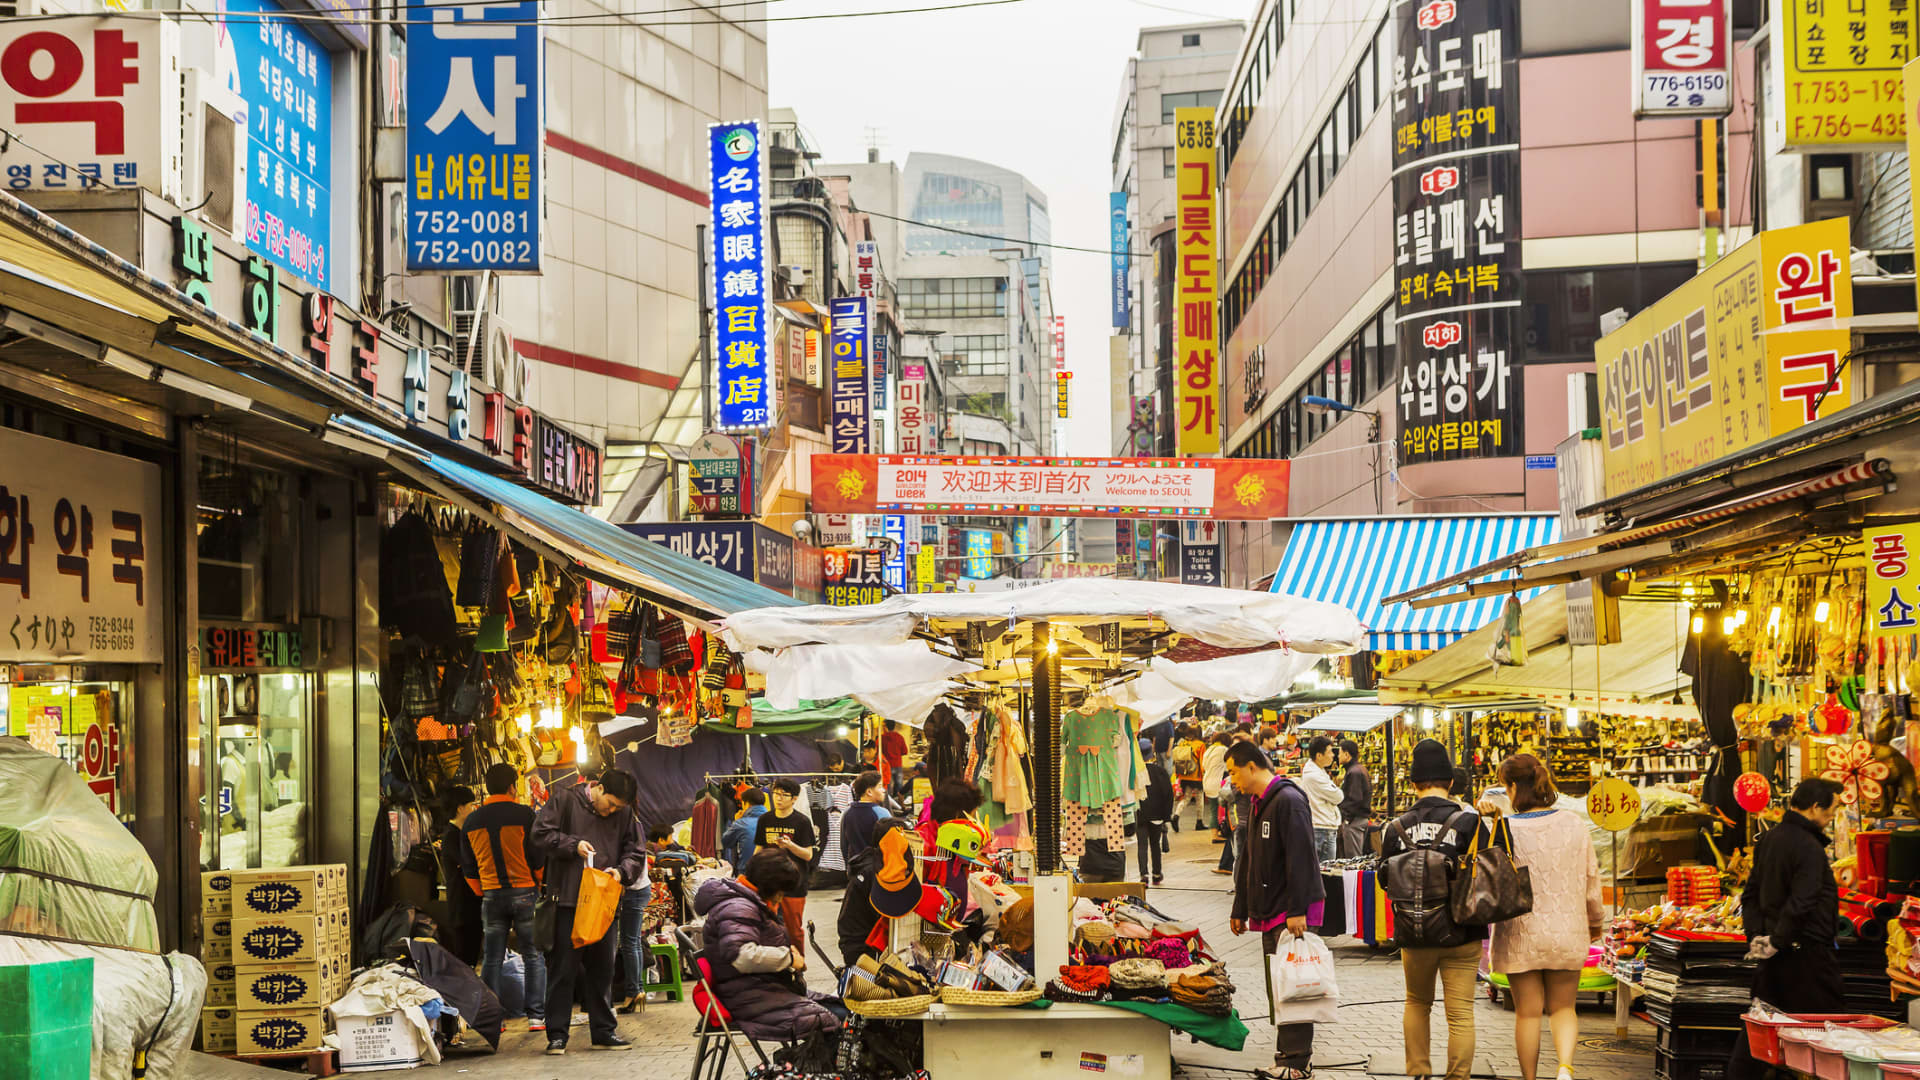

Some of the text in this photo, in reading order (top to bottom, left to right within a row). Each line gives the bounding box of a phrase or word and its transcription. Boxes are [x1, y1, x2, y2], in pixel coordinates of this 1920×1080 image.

[1656, 0, 1714, 67] 경
[1807, 46, 1908, 65] 포장지
[1, 29, 139, 156] 약
[258, 55, 318, 132] 식당유니폼
[1648, 75, 1724, 91] 776-6150
[8, 162, 138, 189] 영진큐텐
[415, 153, 532, 201] 남.여유니폼
[415, 210, 529, 234] 752-0081
[1396, 194, 1505, 267] 토탈패션
[415, 241, 532, 265] 752-0082
[718, 166, 763, 405] 名家眼鏡百貨店
[1181, 162, 1216, 436] 그릇도매상가
[1426, 326, 1457, 343] 지하
[1774, 249, 1842, 426] 완구
[1400, 350, 1511, 421] 수입상가
[1605, 306, 1713, 452] 선일이벤트
[742, 408, 767, 423] 2F
[1403, 418, 1502, 456] 수입상품일체
[703, 478, 736, 493] 그릇
[896, 470, 927, 482] 2014
[941, 470, 1091, 495] 欢迎来到首尔
[1105, 473, 1193, 486] ソウルへようこそ
[1105, 487, 1193, 497] Welcome to SEOUL
[721, 496, 737, 511] 안경
[648, 532, 744, 572] 매상가
[845, 553, 881, 584] 그릇
[9, 614, 76, 650] くすりや
[88, 616, 134, 634] 752-8344
[88, 635, 134, 650] 755-6059
[1591, 792, 1640, 816] おもちゃ
[252, 889, 297, 903] 박카스
[270, 902, 279, 911] D
[249, 933, 297, 948] 박카스
[268, 947, 278, 957] D
[257, 980, 301, 994] 박카스
[275, 993, 285, 1002] D
[257, 1025, 301, 1039] 박카스
[275, 1038, 285, 1047] D
